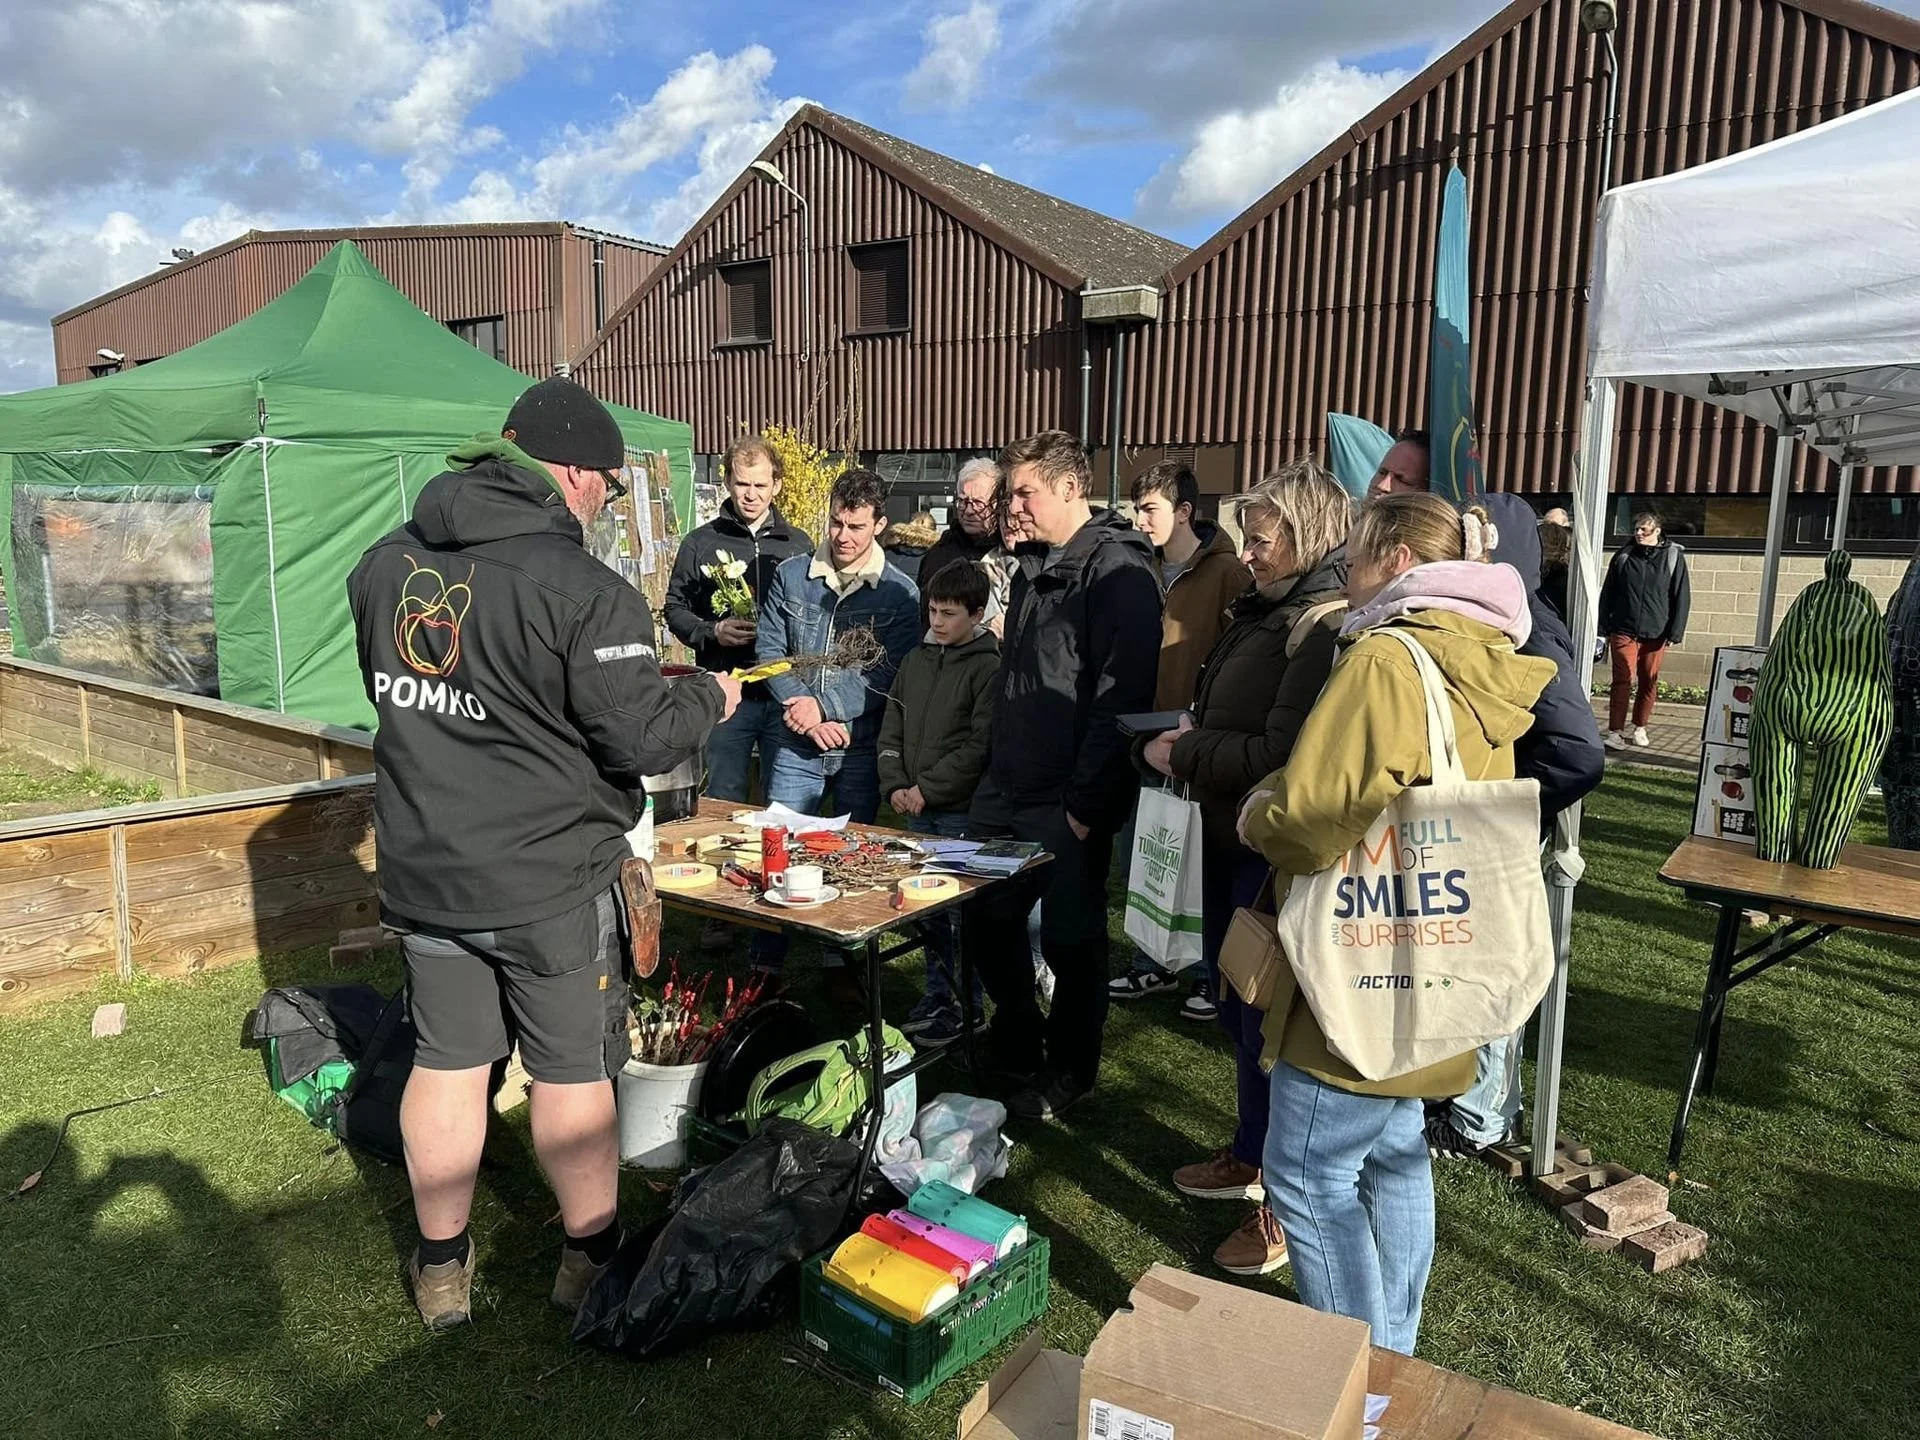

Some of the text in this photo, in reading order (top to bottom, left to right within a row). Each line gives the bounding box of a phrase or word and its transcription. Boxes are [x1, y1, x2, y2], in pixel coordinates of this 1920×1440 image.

[374, 671, 487, 722] POMKO
[1400, 818, 1462, 846] FULL
[1401, 846, 1434, 871] OF
[1333, 869, 1471, 919] SMILES
[1331, 922, 1340, 946] AND
[1341, 919, 1473, 948] SURPRISES
